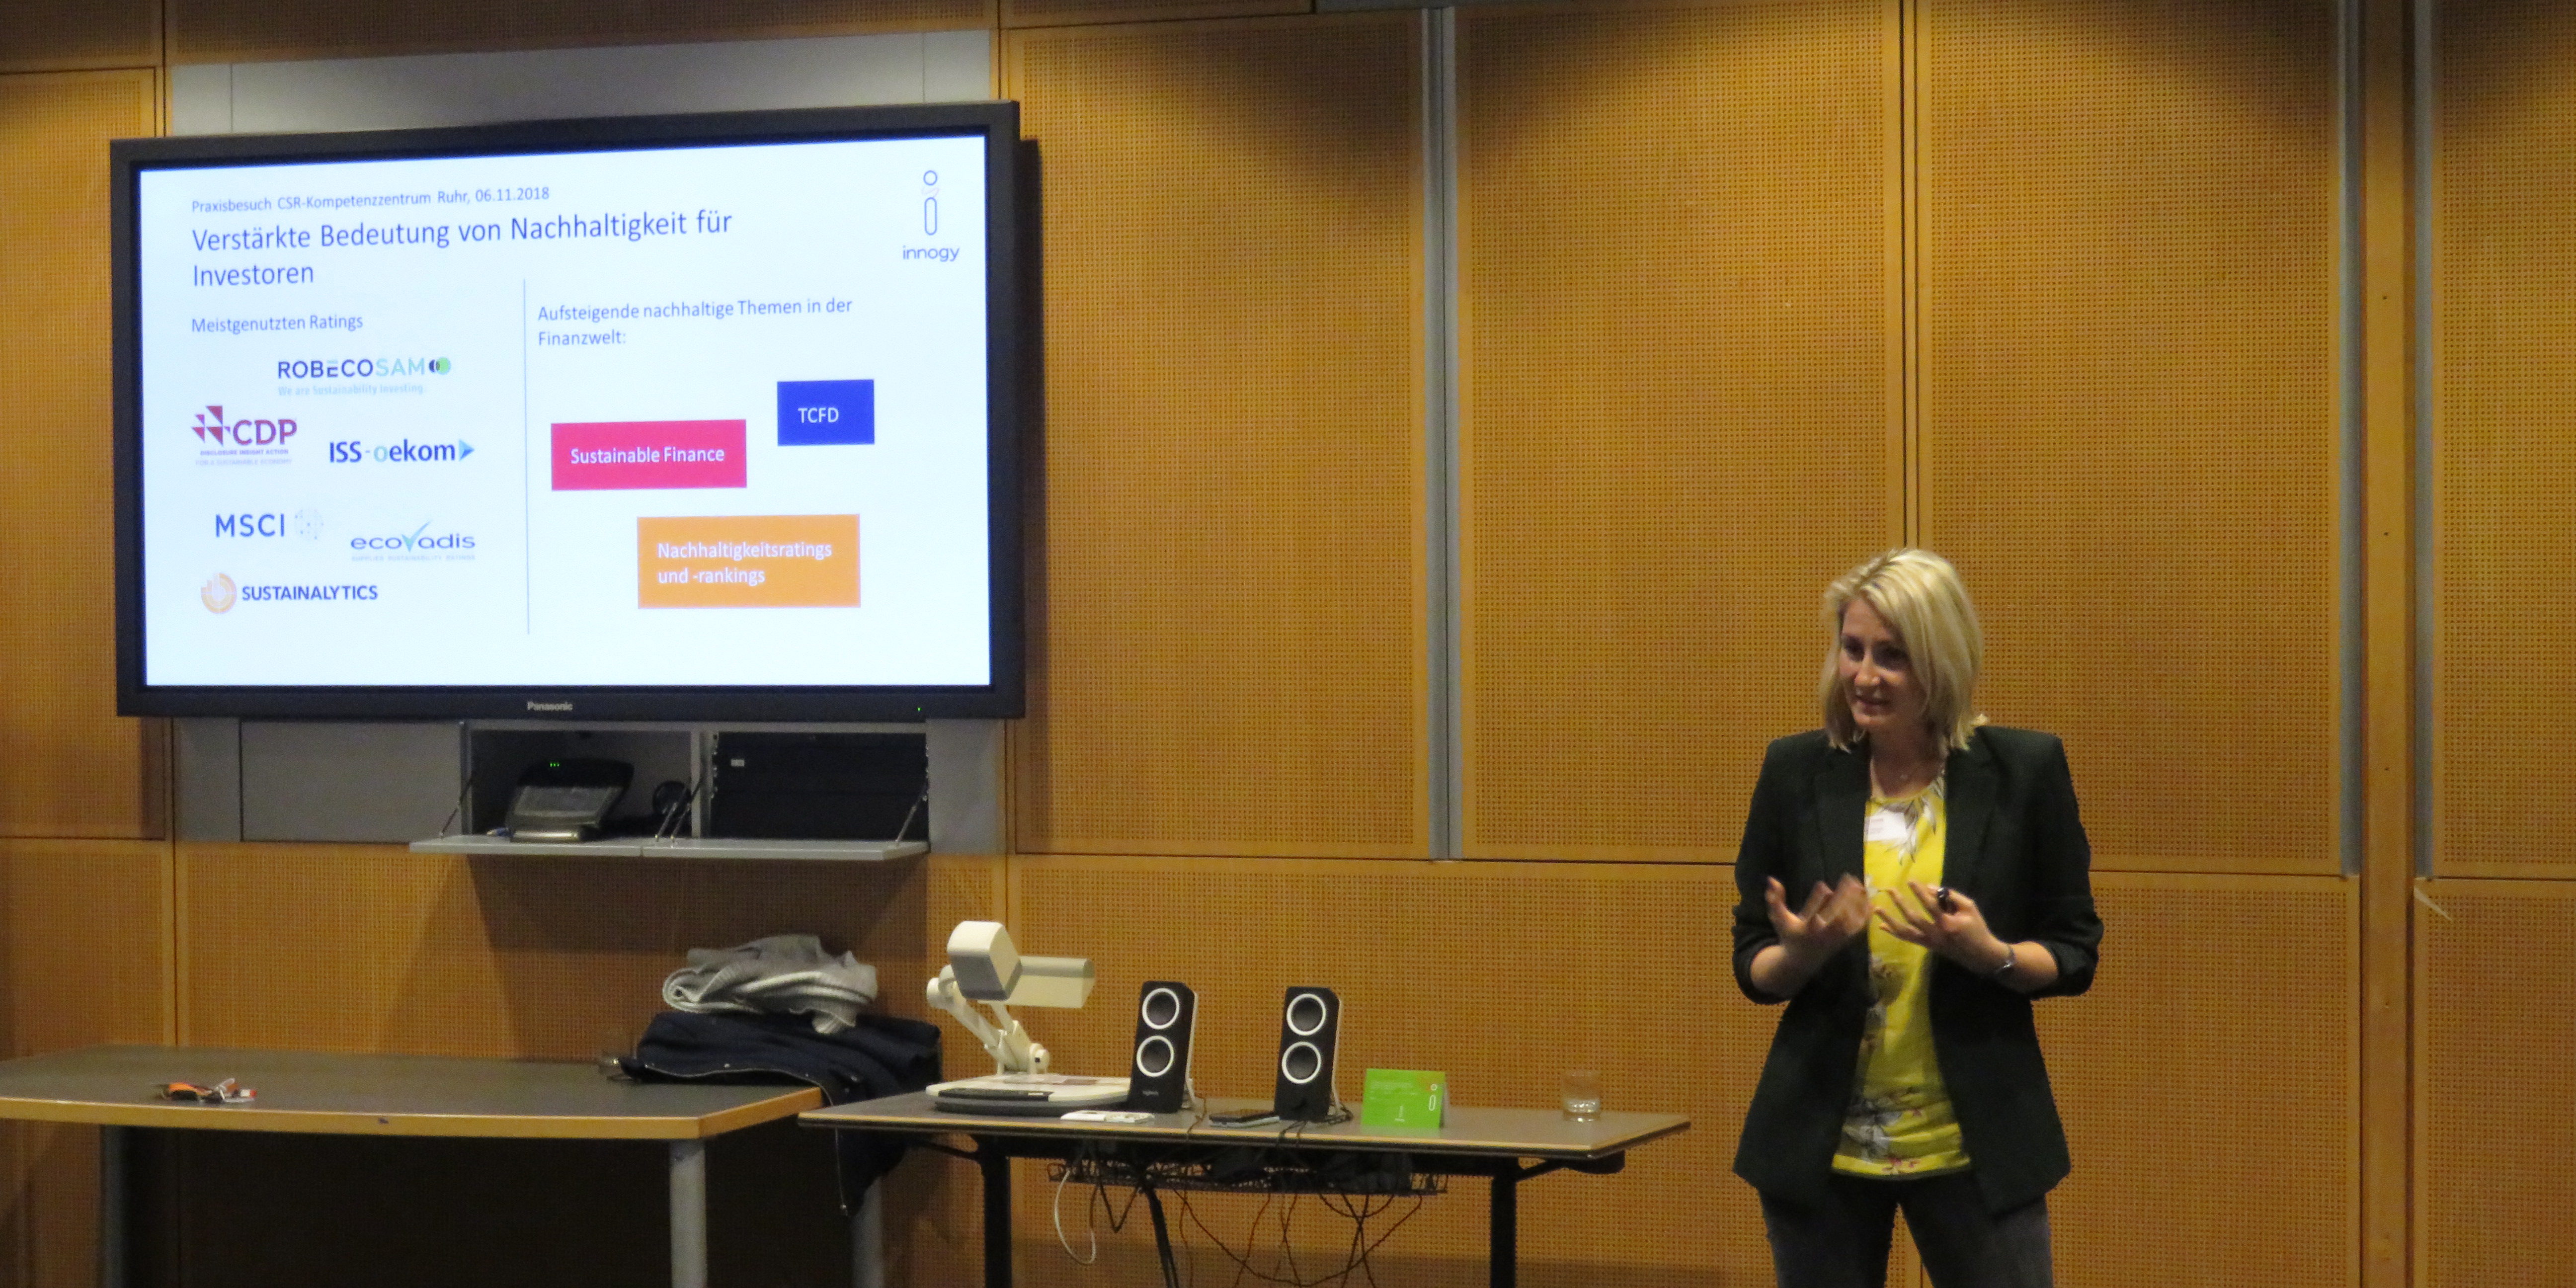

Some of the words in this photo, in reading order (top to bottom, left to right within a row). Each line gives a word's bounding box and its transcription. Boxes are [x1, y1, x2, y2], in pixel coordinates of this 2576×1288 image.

[192, 198, 272, 213] Praxisbesuch
[277, 192, 431, 210] CSR-Kompetenzzentrum
[437, 189, 470, 205] Ruhr,
[475, 186, 550, 203] 06.11.2018
[192, 225, 311, 252] Verstärkte
[321, 222, 450, 249] Bedeutung
[458, 224, 500, 242] von
[511, 211, 687, 242] Nachhaltigkeit
[696, 209, 733, 234] für
[902, 245, 960, 262] innogy
[193, 265, 314, 287] Investoren
[538, 303, 640, 323] Aufsteigende
[644, 301, 734, 320] nachhaltige
[737, 299, 802, 316] Themen
[807, 299, 821, 313] in
[825, 297, 853, 313] der
[192, 317, 306, 335] Meistgenutzten
[310, 315, 363, 331] Ratings
[538, 328, 626, 346] Finanzwelt:
[798, 407, 839, 423] TCFD
[232, 418, 298, 446] CDP
[570, 447, 660, 464] Sustainable
[664, 446, 725, 463] Finance
[215, 513, 285, 538] MSCI
[657, 541, 832, 561] Nachhaltigkeitsratings
[658, 567, 688, 584] und
[693, 566, 766, 586] -rankings
[242, 584, 379, 602] SUSTAINALYTICS
[527, 701, 573, 711] Panasonic
